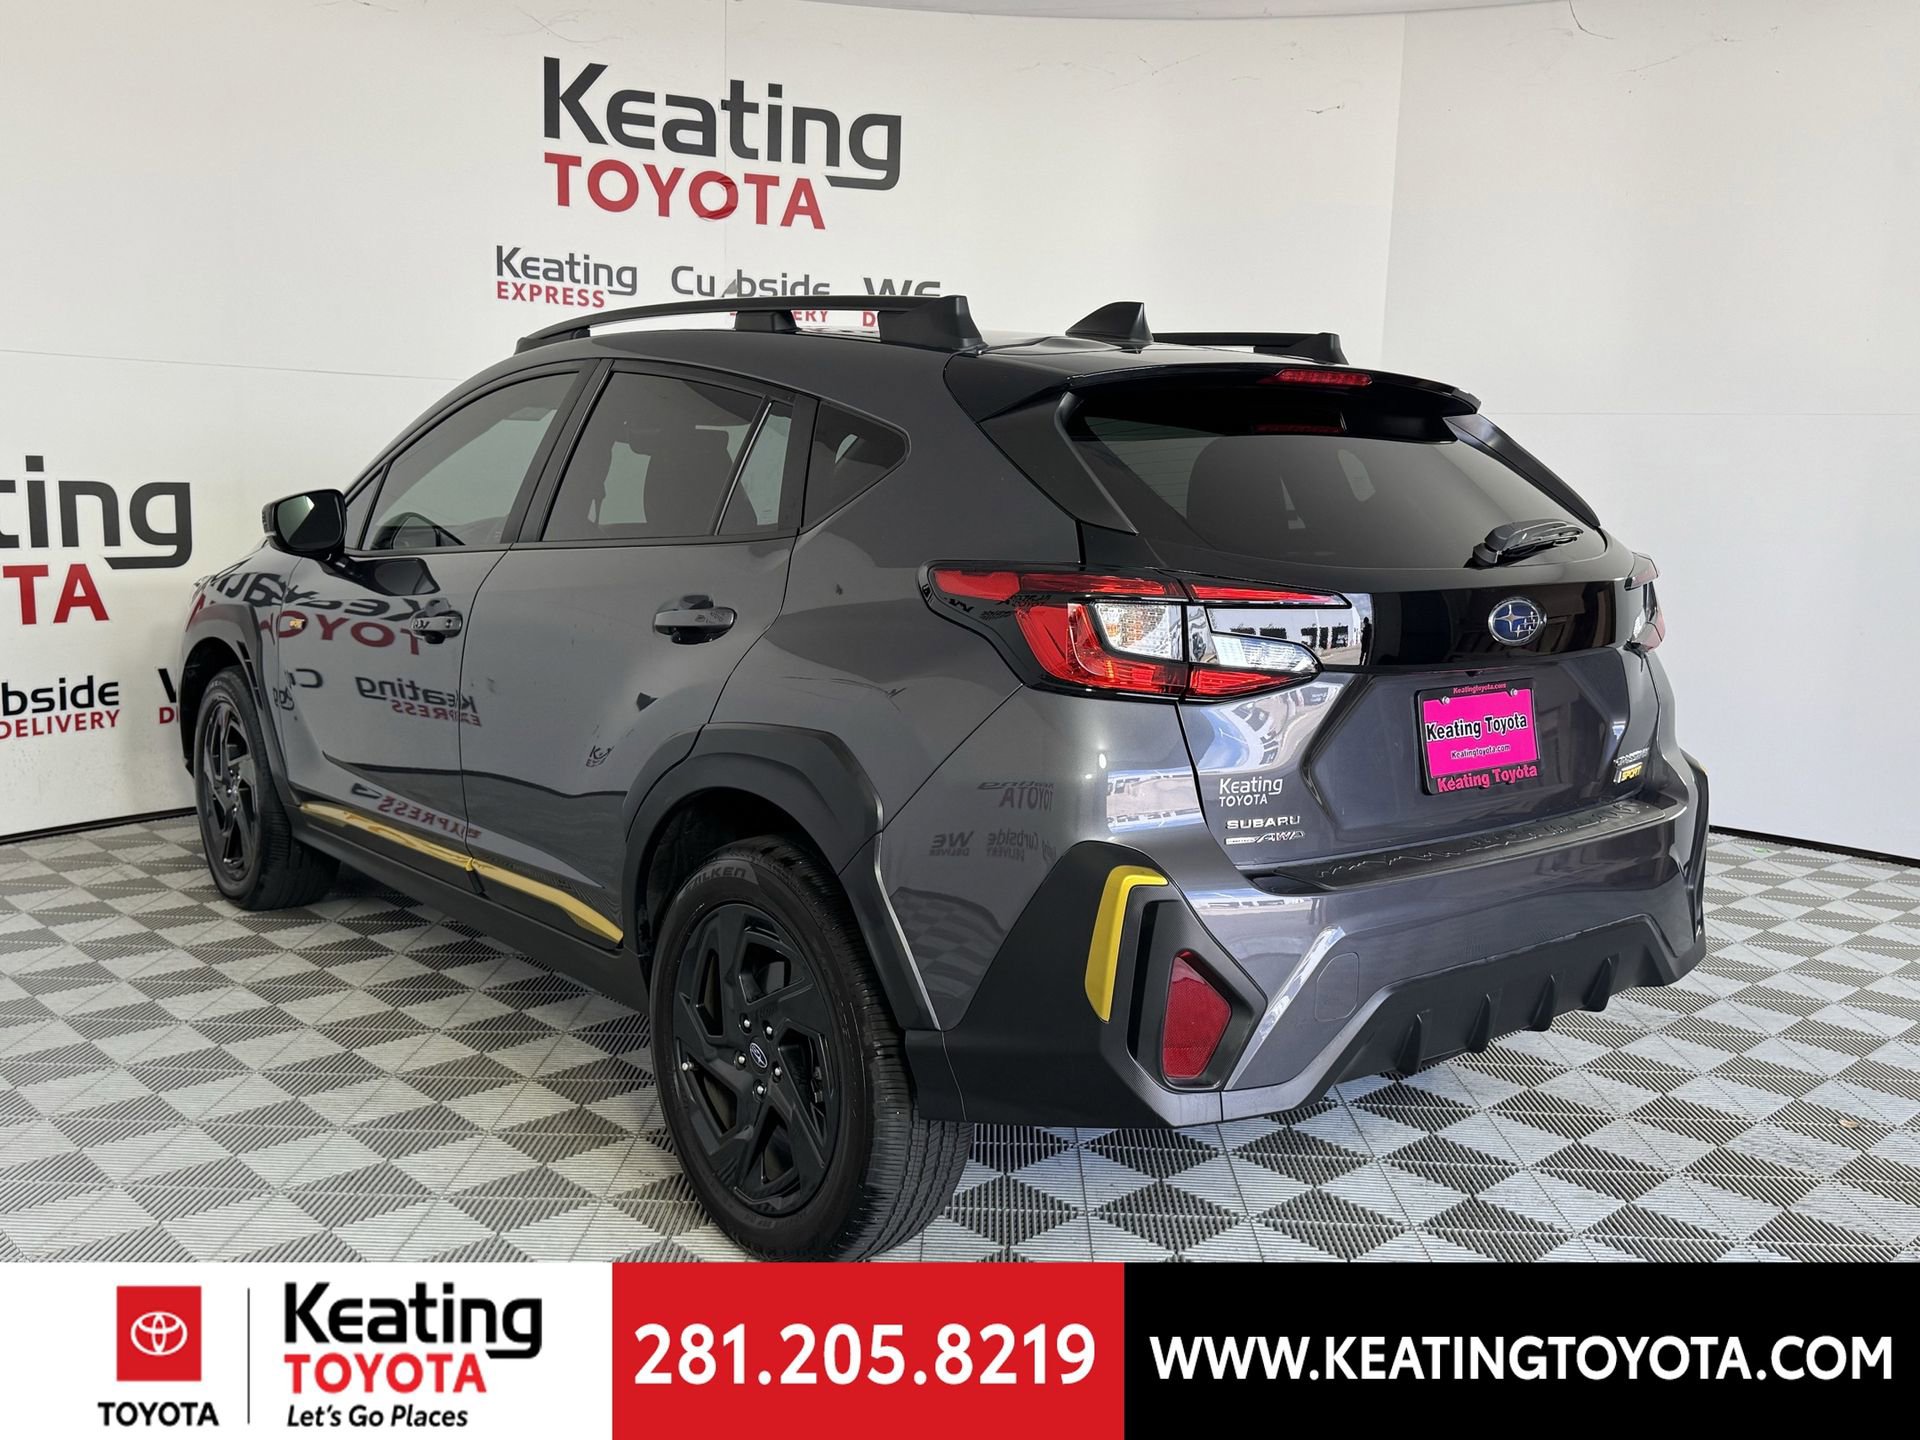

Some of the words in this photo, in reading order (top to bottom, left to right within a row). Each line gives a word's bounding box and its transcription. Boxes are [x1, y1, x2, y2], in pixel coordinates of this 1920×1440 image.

[543, 56, 902, 191] Keating
[544, 152, 826, 230] TOYOTA
[496, 245, 637, 297] Keating
[671, 265, 831, 298] Cubside
[496, 281, 605, 308] EXPRESS
[2, 563, 109, 625] TA
[1, 675, 119, 717] bside
[0, 709, 120, 740] DELIVERY
[1426, 720, 1481, 740] Keating
[1485, 713, 1527, 735] Toyota
[1451, 744, 1511, 760] Keatingtoyota.com
[1219, 776, 1284, 796] Keating
[1437, 773, 1490, 793] Keating
[1492, 765, 1538, 784] Toyota
[1219, 794, 1268, 807] TOYOTA
[1226, 816, 1300, 829] SUBARU
